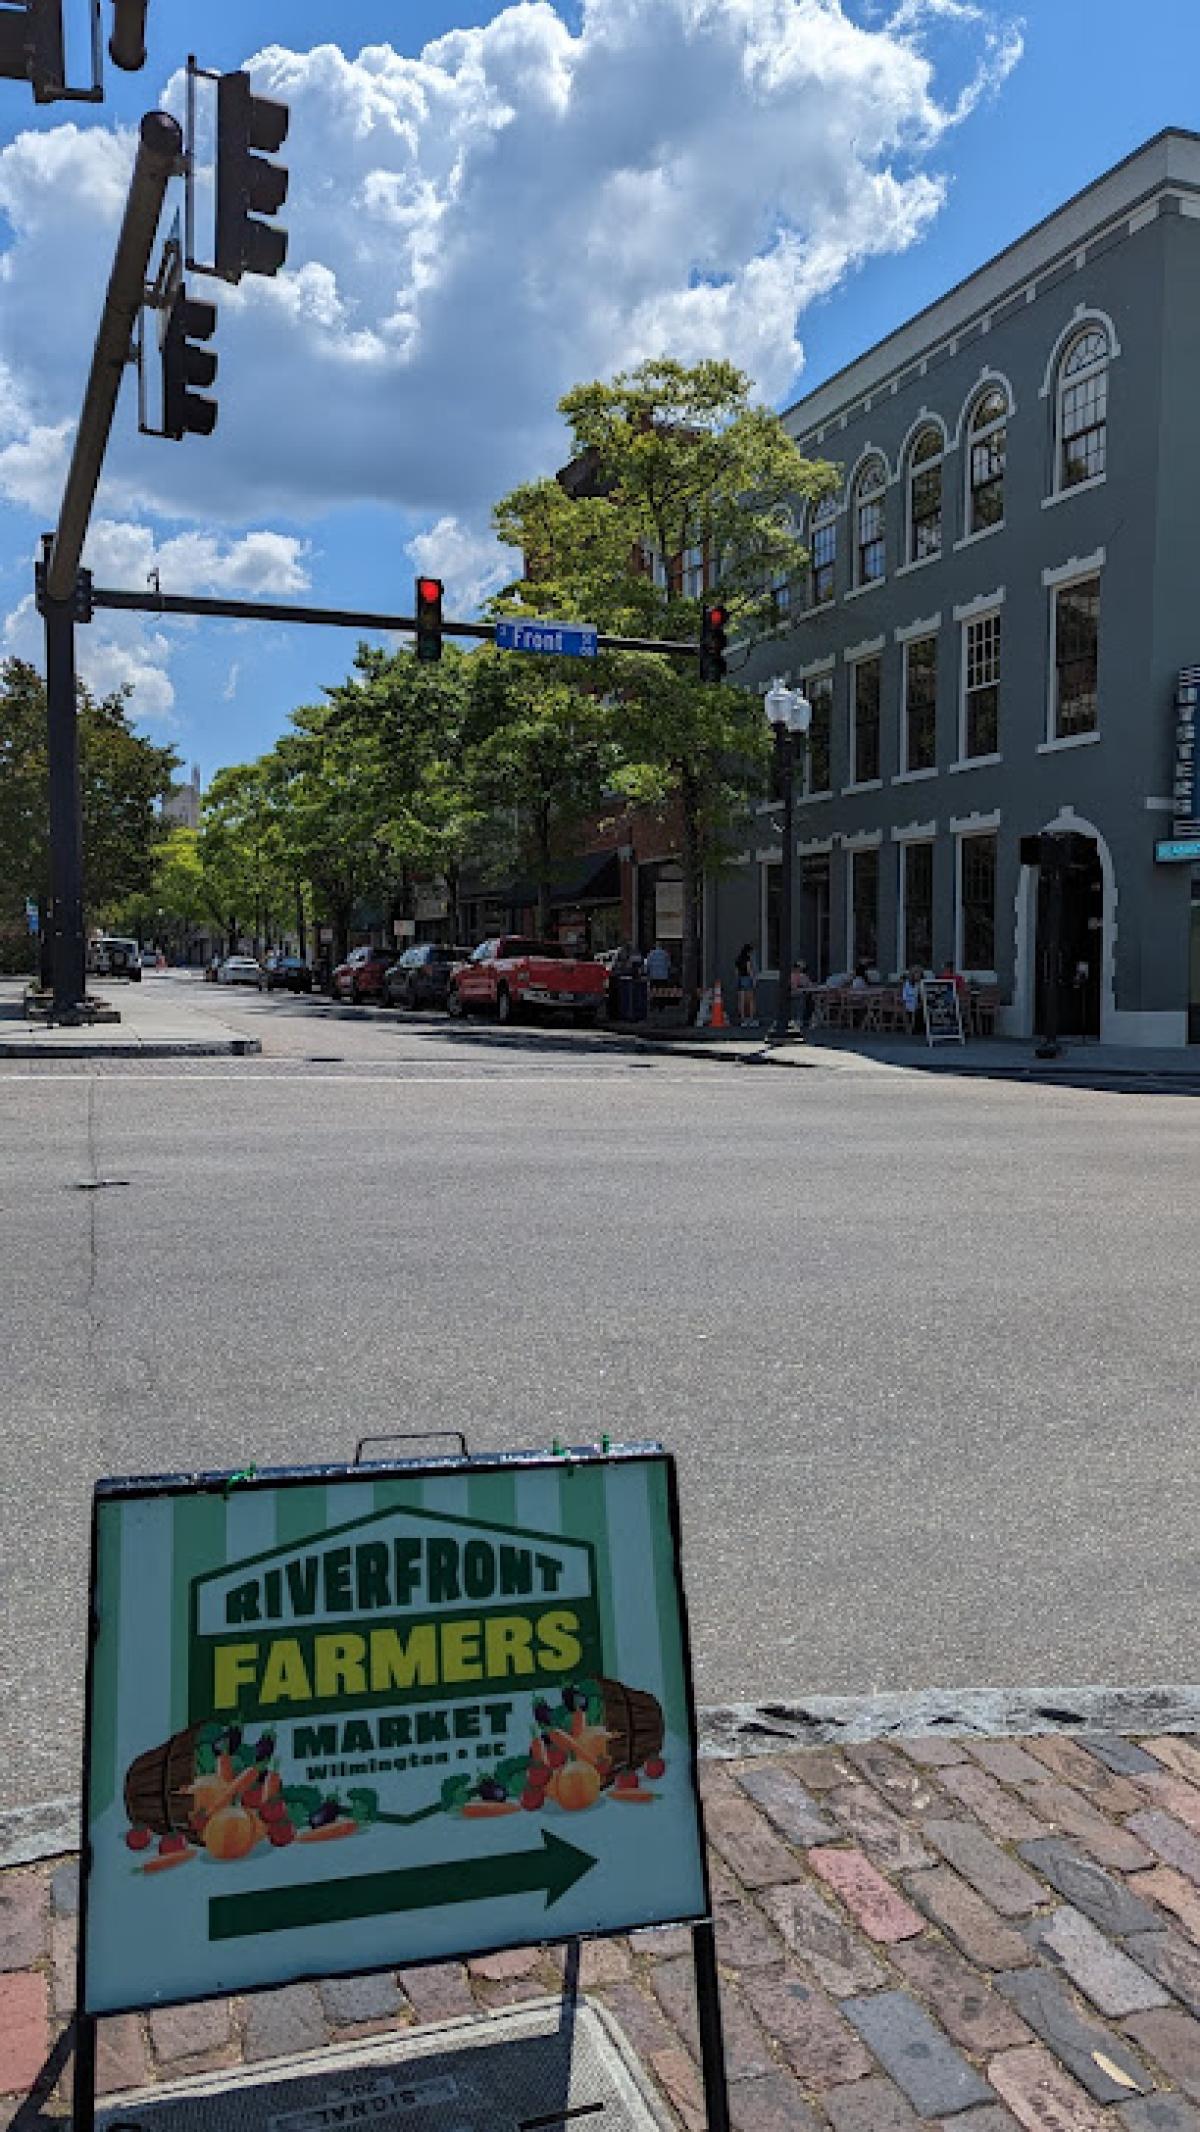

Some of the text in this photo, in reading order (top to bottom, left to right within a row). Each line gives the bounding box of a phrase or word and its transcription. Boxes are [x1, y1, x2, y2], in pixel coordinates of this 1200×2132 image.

[514, 623, 562, 650] Front
[225, 1537, 565, 1624] RIVERFRONT
[214, 1610, 583, 1709] FARMERS
[292, 1702, 513, 1759] MARKET
[306, 1751, 449, 1780] Wilmington
